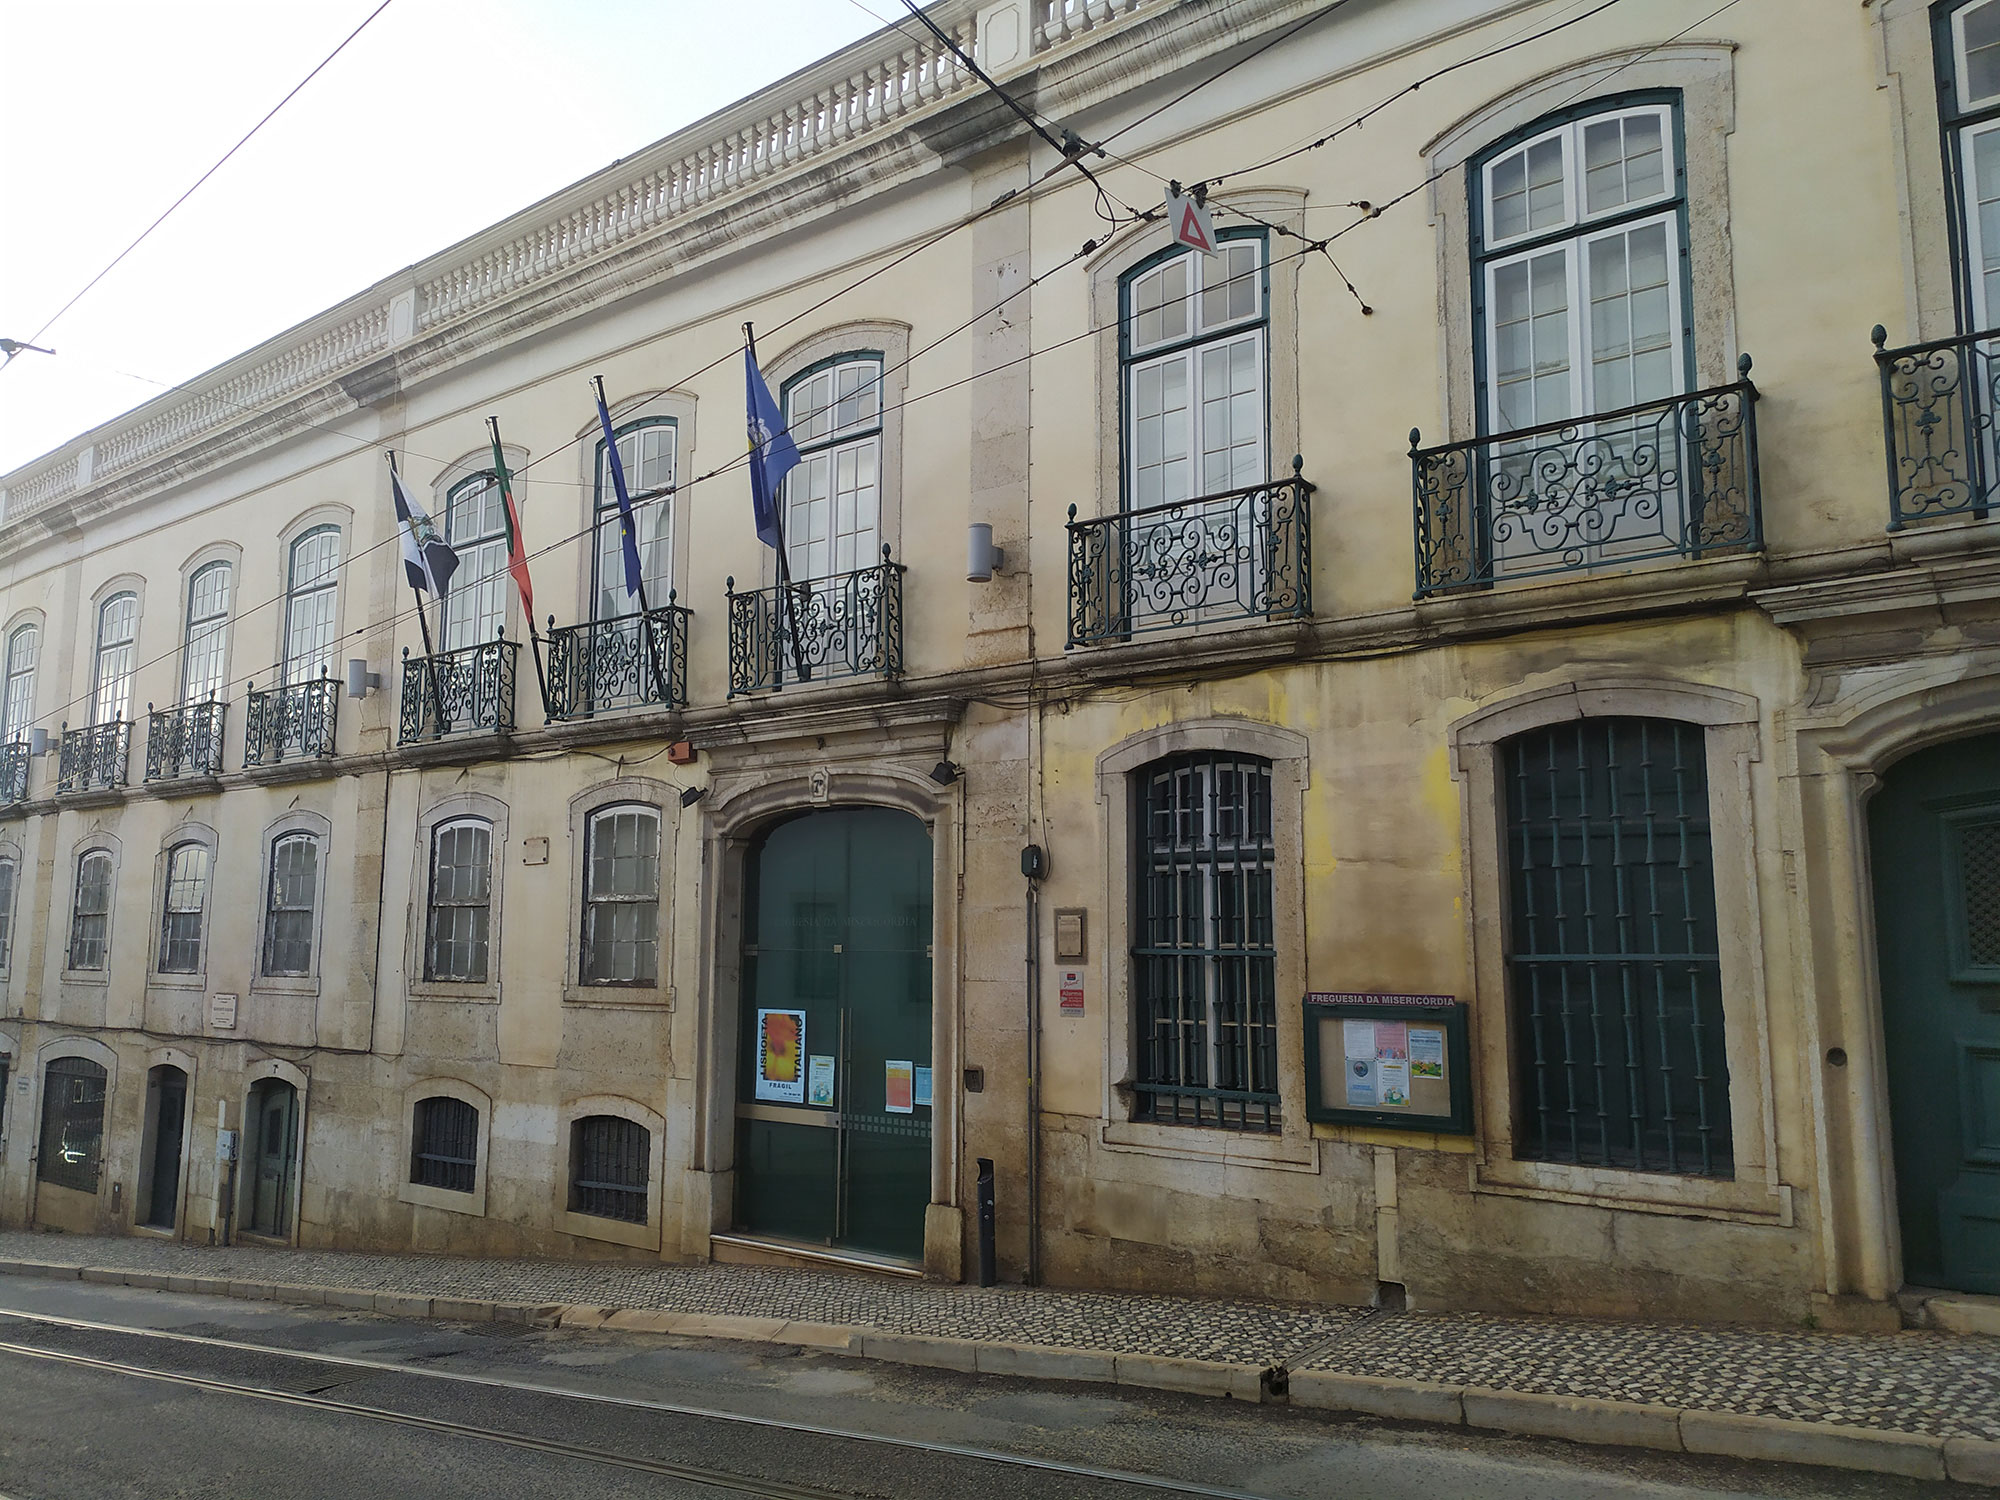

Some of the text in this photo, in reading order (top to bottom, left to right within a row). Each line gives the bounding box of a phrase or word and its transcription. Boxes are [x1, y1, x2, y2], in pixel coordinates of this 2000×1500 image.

[1311, 994, 1455, 1006] FREGUESIA DA MISERICÓRDIA
[760, 1017, 768, 1075] LISBOETA
[794, 1018, 803, 1078] ITALIANO
